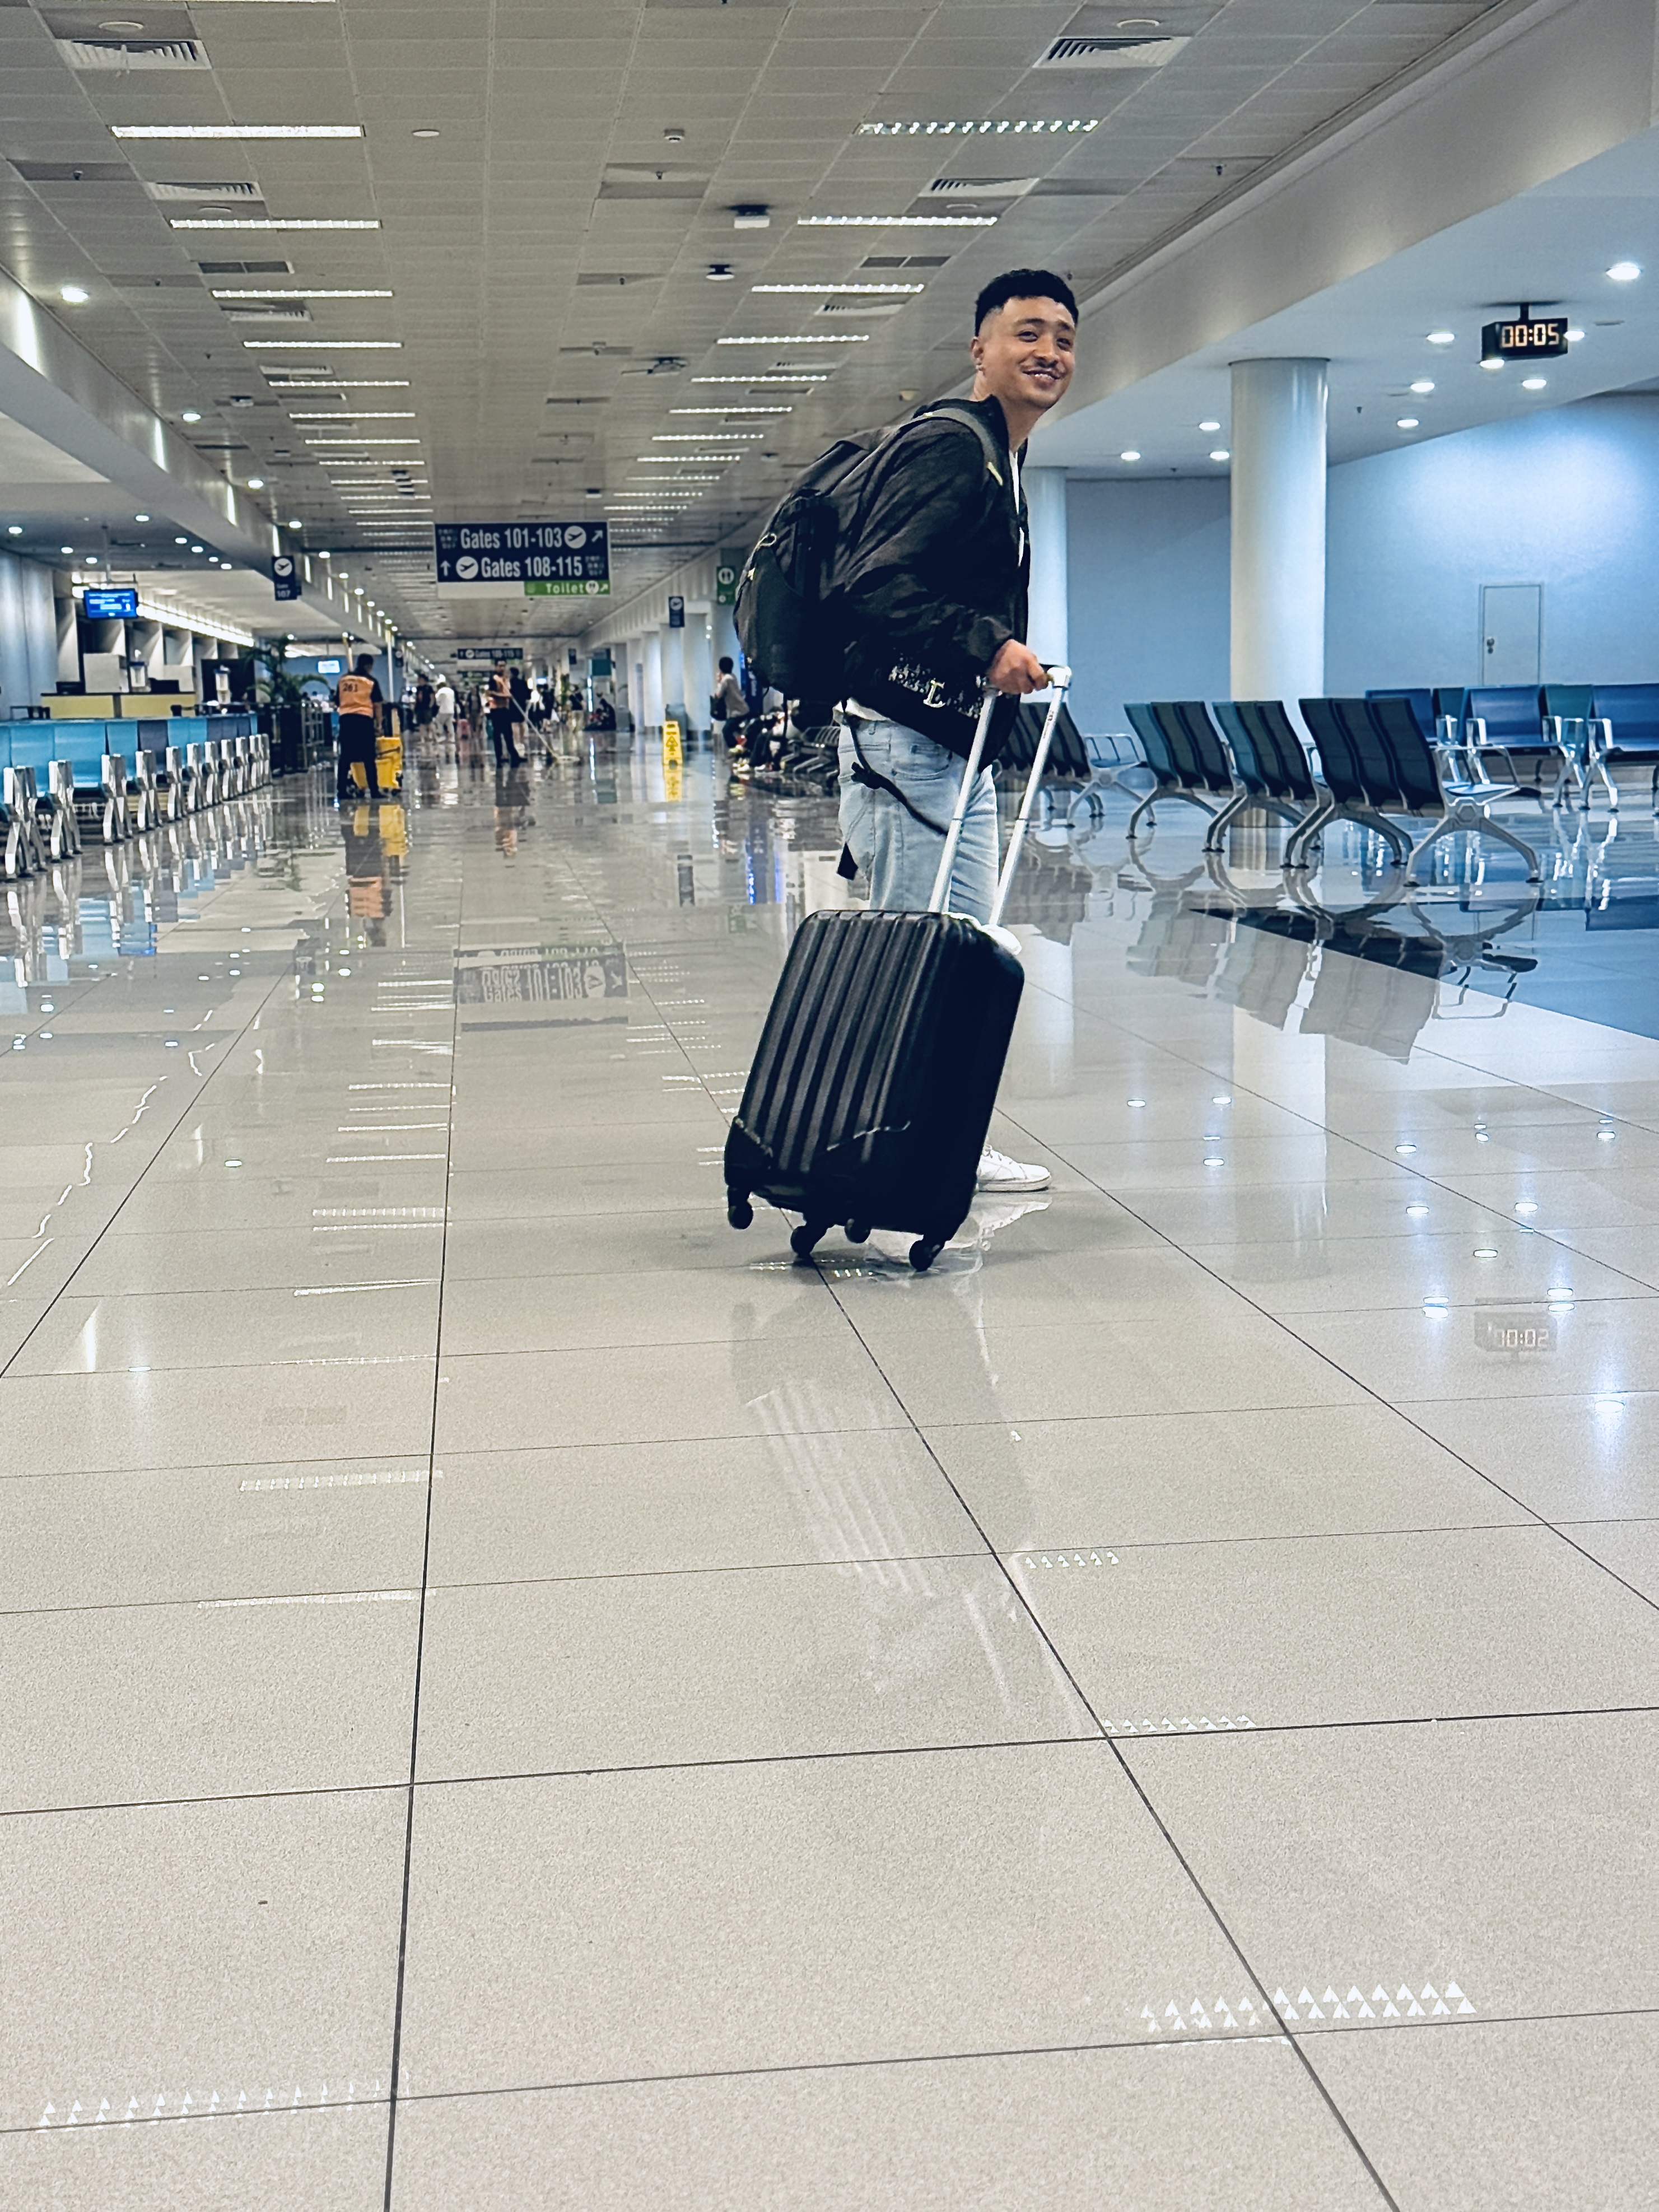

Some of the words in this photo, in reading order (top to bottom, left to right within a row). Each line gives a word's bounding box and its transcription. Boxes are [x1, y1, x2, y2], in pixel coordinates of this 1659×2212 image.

[1502, 323, 1559, 347] 00:05
[460, 528, 500, 549] Gates
[504, 527, 562, 548] 101-103
[481, 557, 521, 578] Gates
[525, 556, 582, 577] 108-115
[546, 582, 584, 594] Toilet
